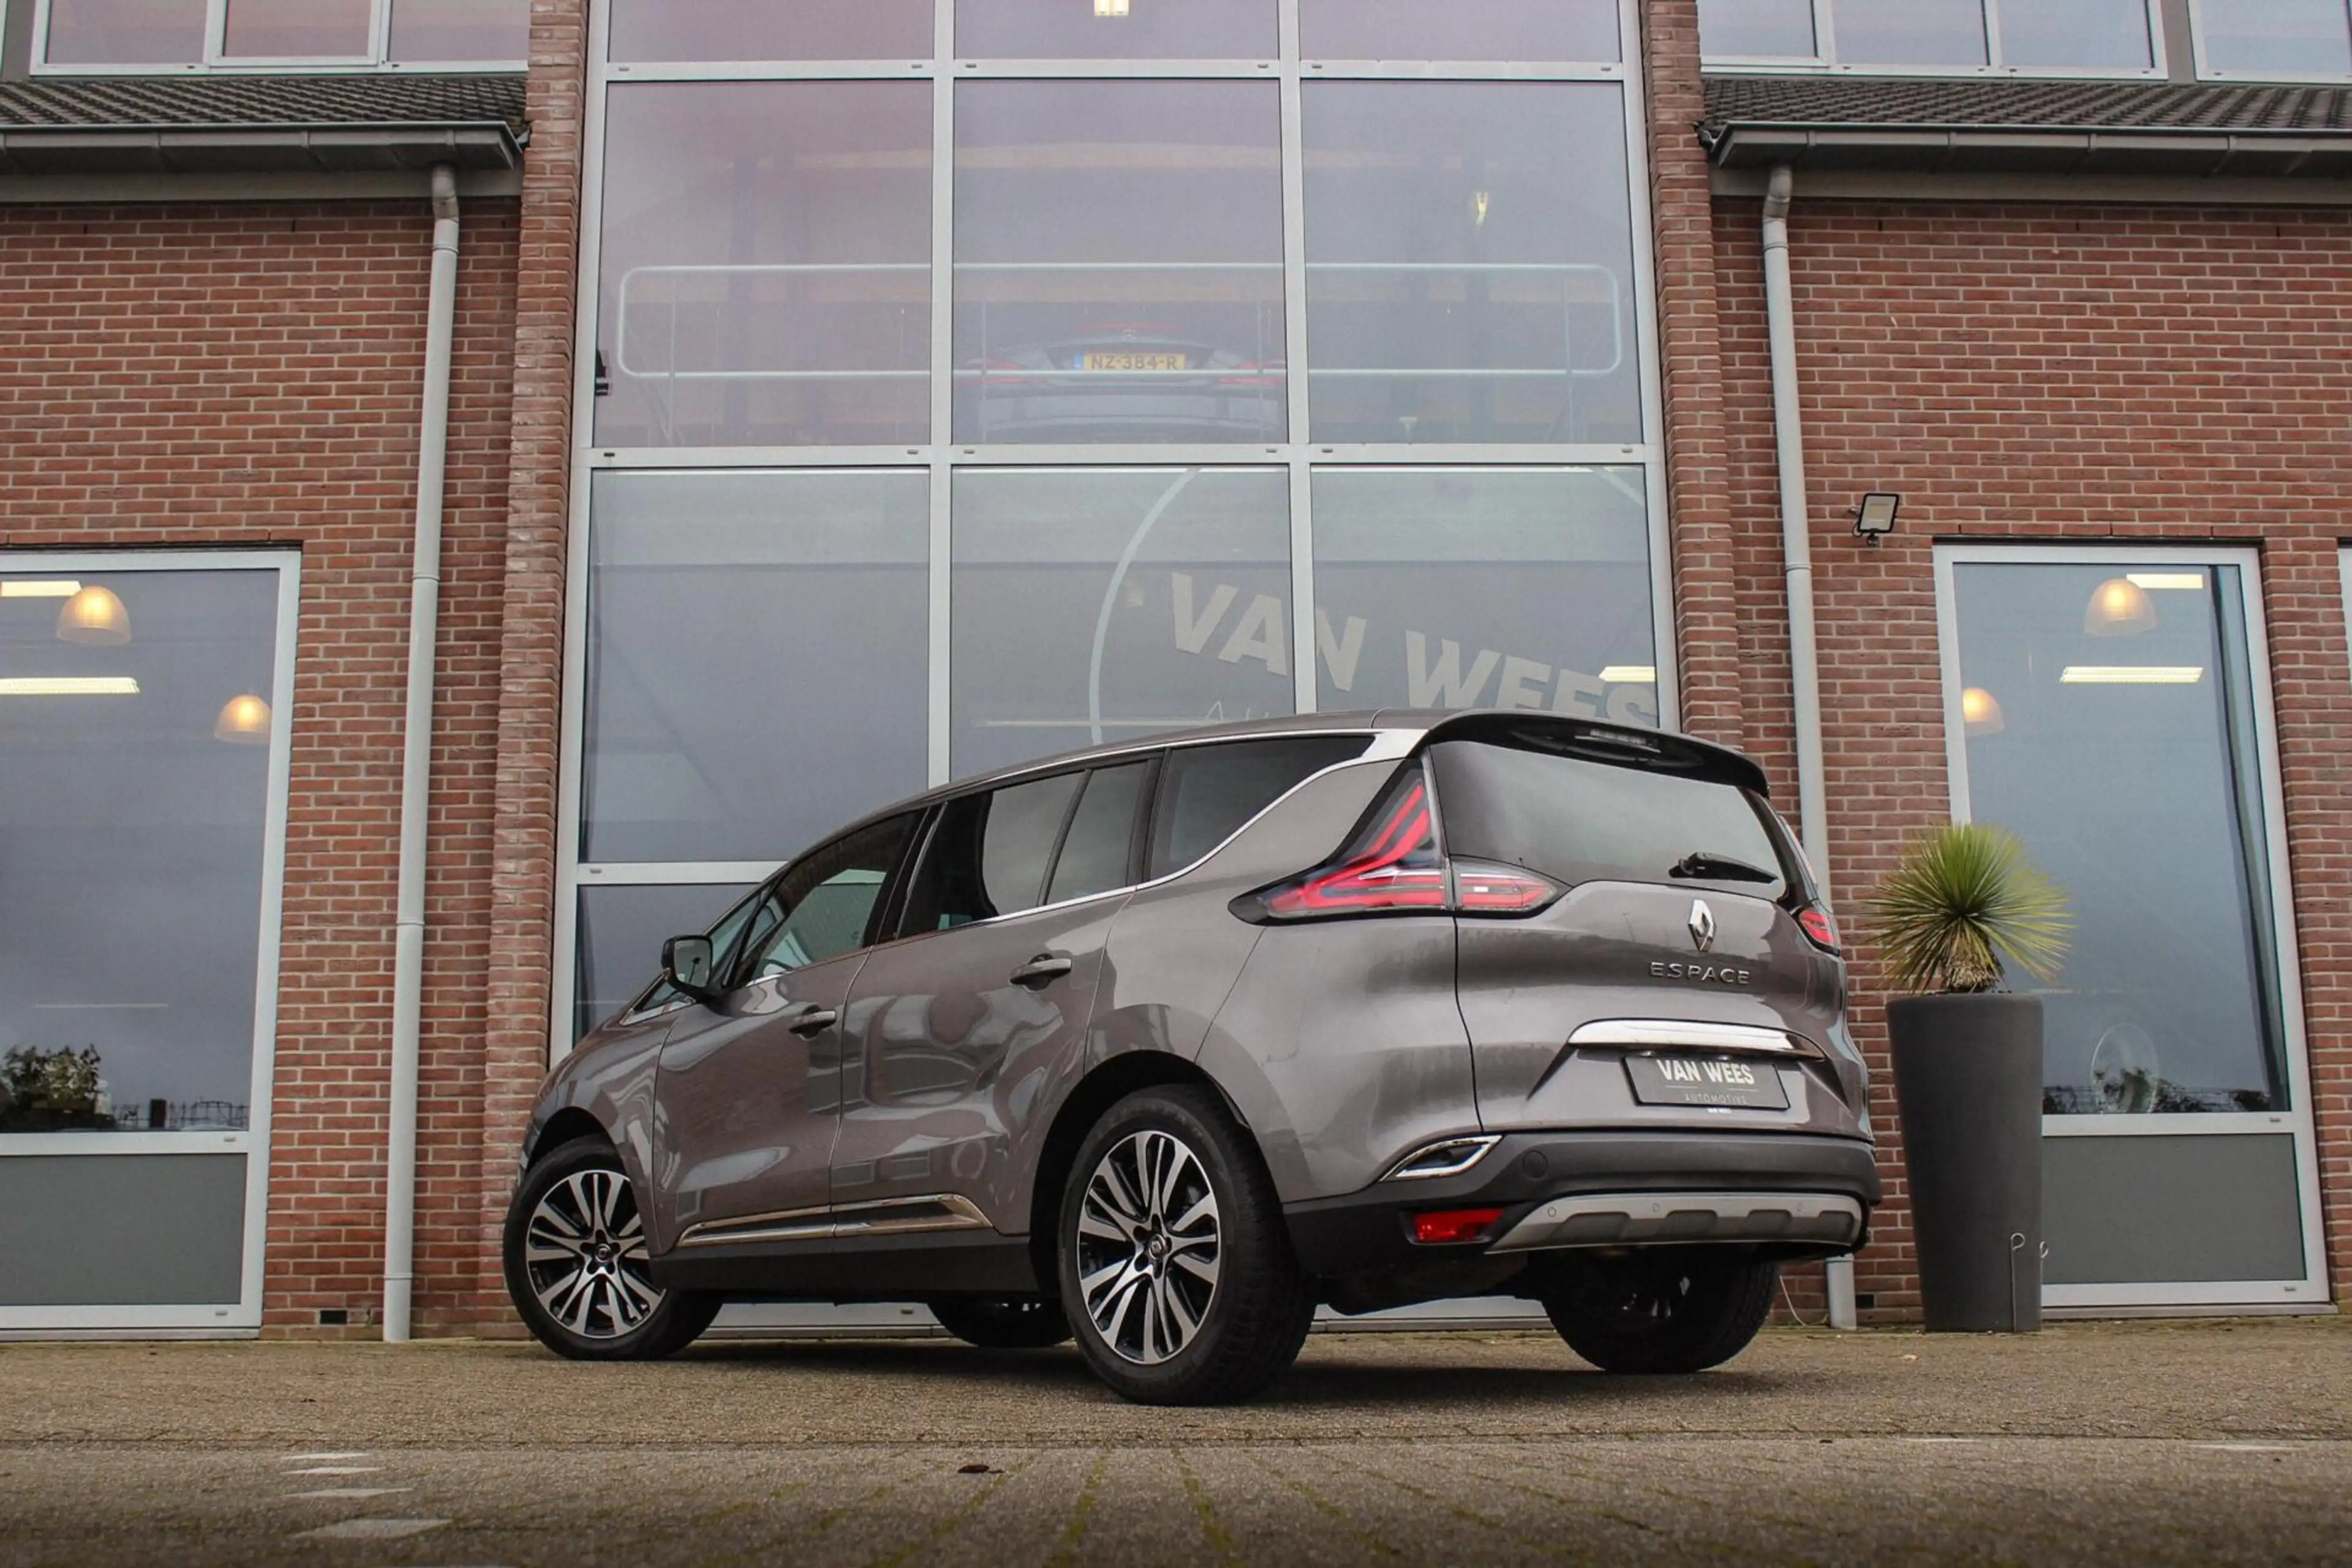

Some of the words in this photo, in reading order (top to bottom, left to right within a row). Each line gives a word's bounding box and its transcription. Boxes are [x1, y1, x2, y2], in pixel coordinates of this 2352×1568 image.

[1171, 571, 1367, 692] VAN
[1405, 630, 1659, 728] WEES
[1650, 961, 1750, 984] ESPACE
[1656, 1059, 1702, 1082] VAN
[1702, 1061, 1755, 1085] WEES
[1685, 1093, 1747, 1105] AUTOMOTIVE
